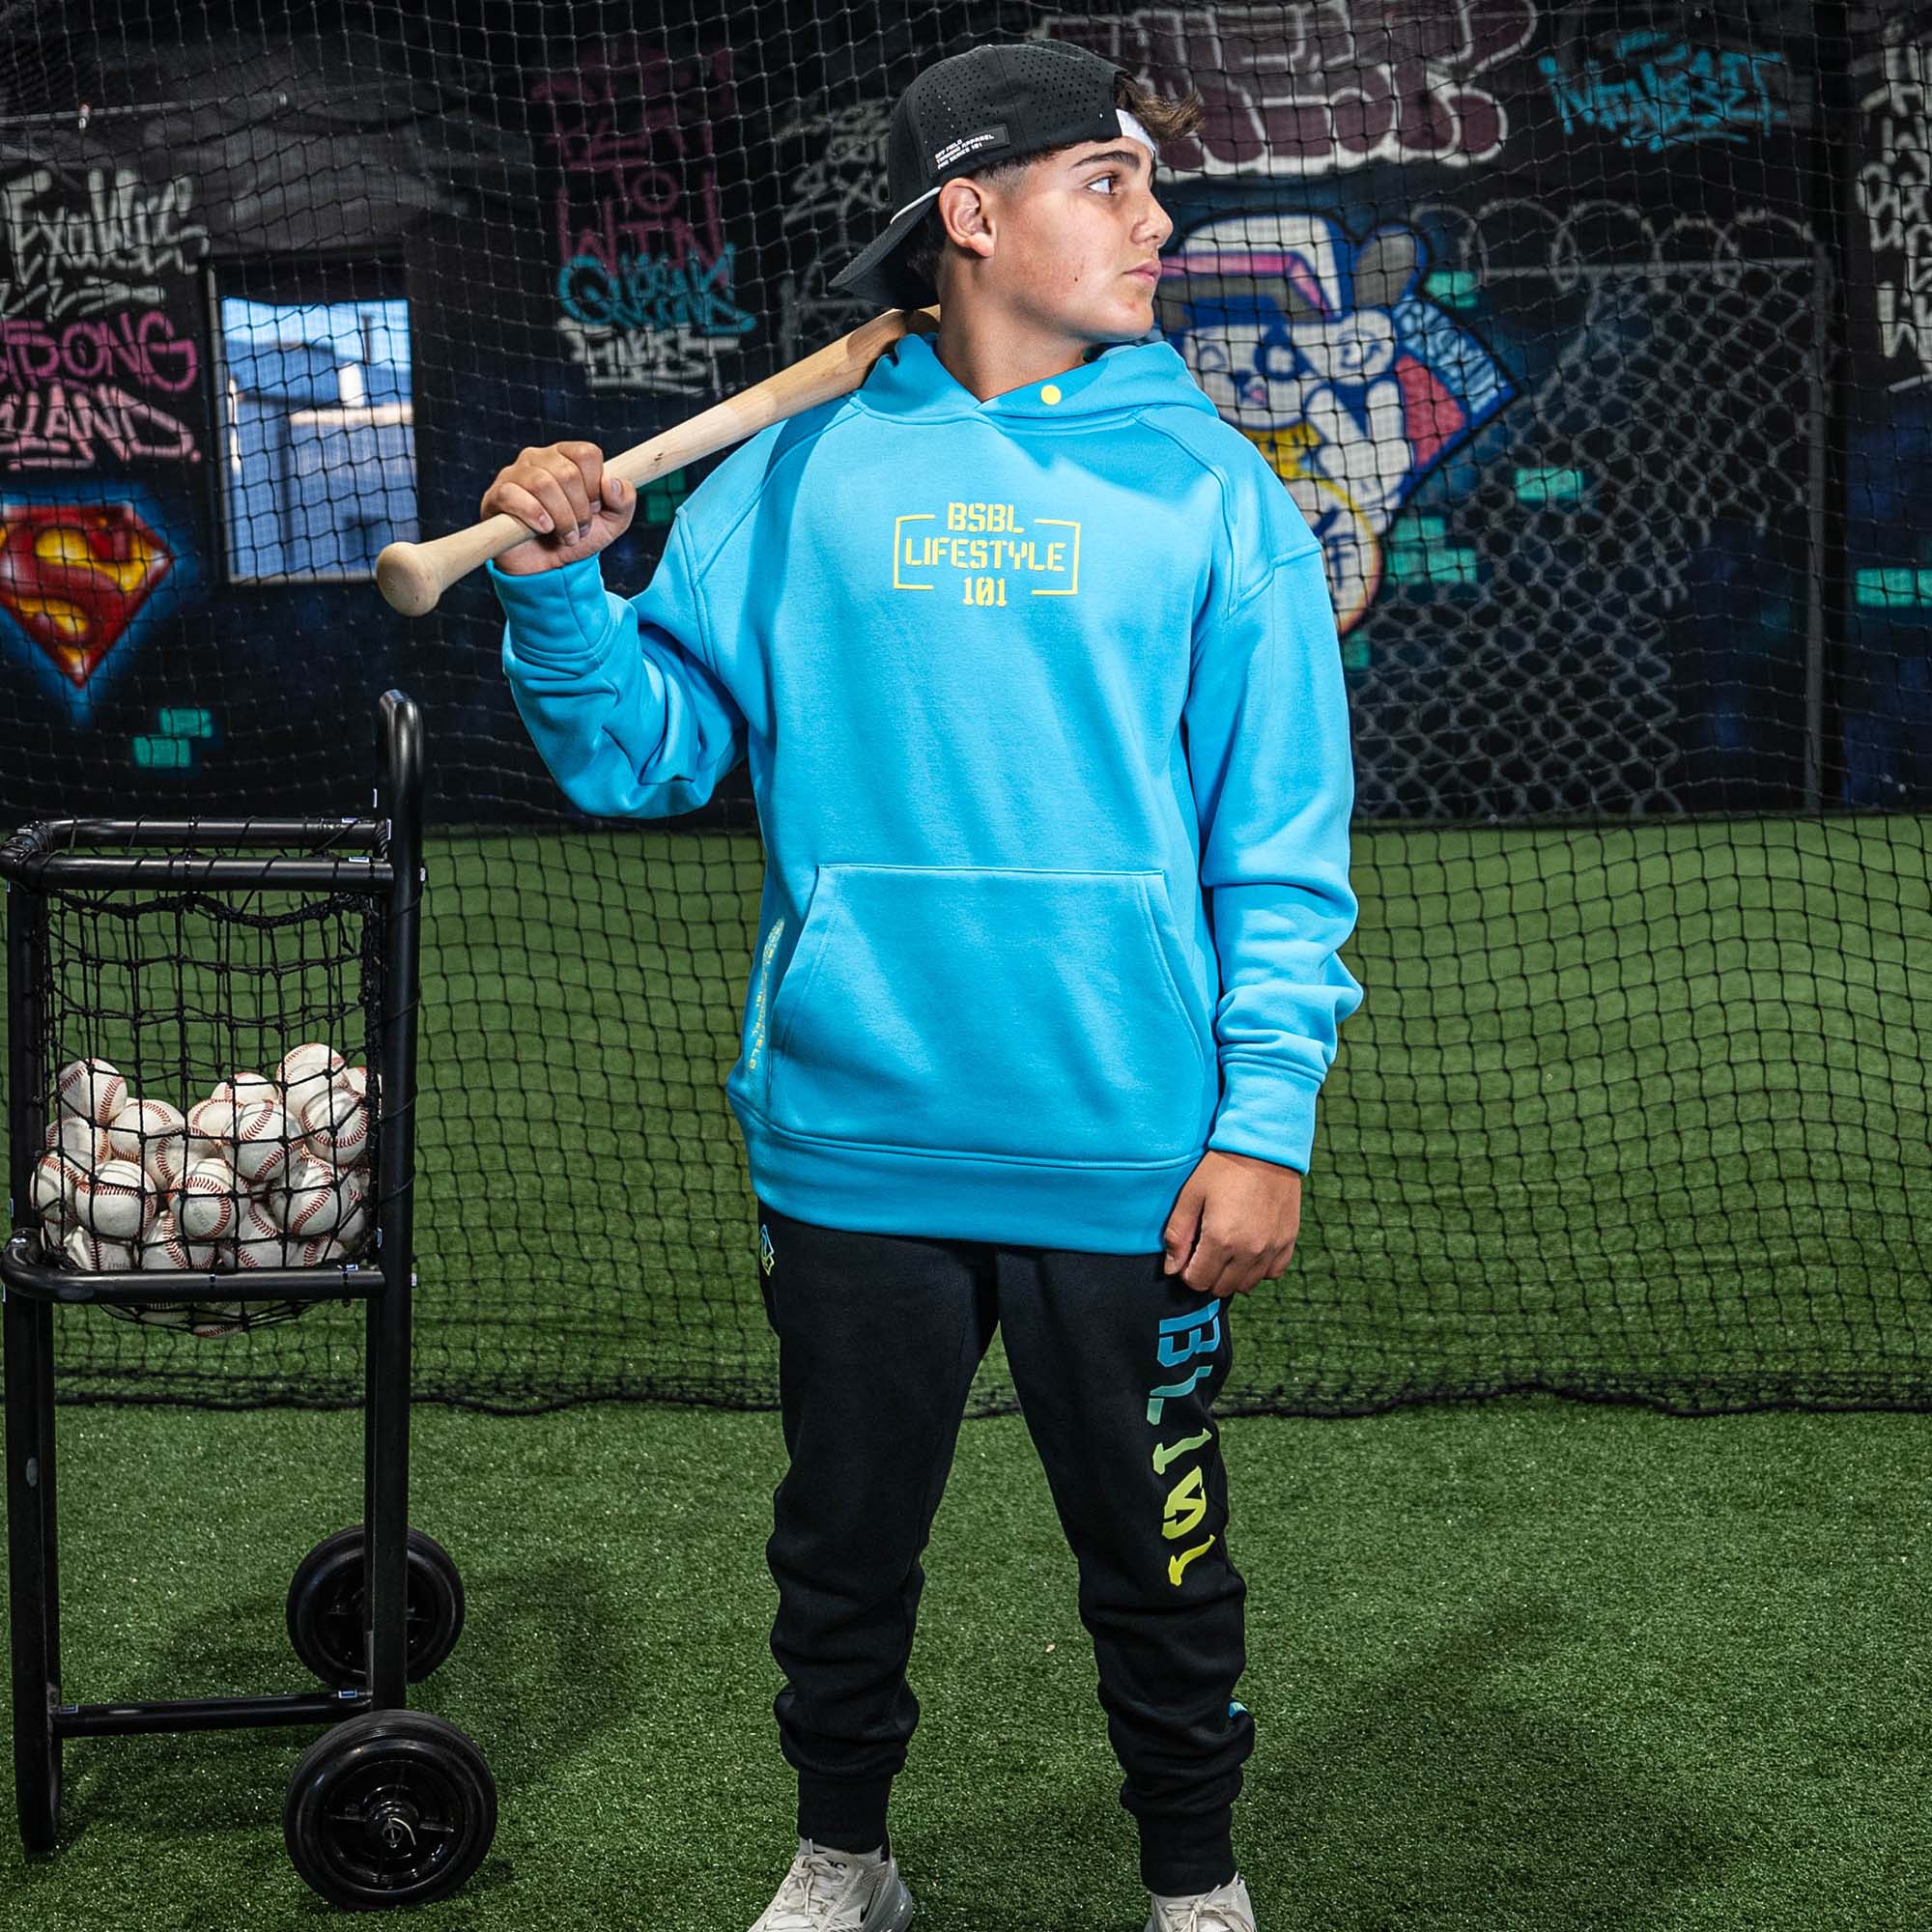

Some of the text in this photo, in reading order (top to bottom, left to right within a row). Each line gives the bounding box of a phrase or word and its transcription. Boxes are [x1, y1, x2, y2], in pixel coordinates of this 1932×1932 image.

[947, 501, 1025, 533] BSBL
[904, 537, 1066, 572] LIFESTYLE
[962, 577, 1008, 607] 101
